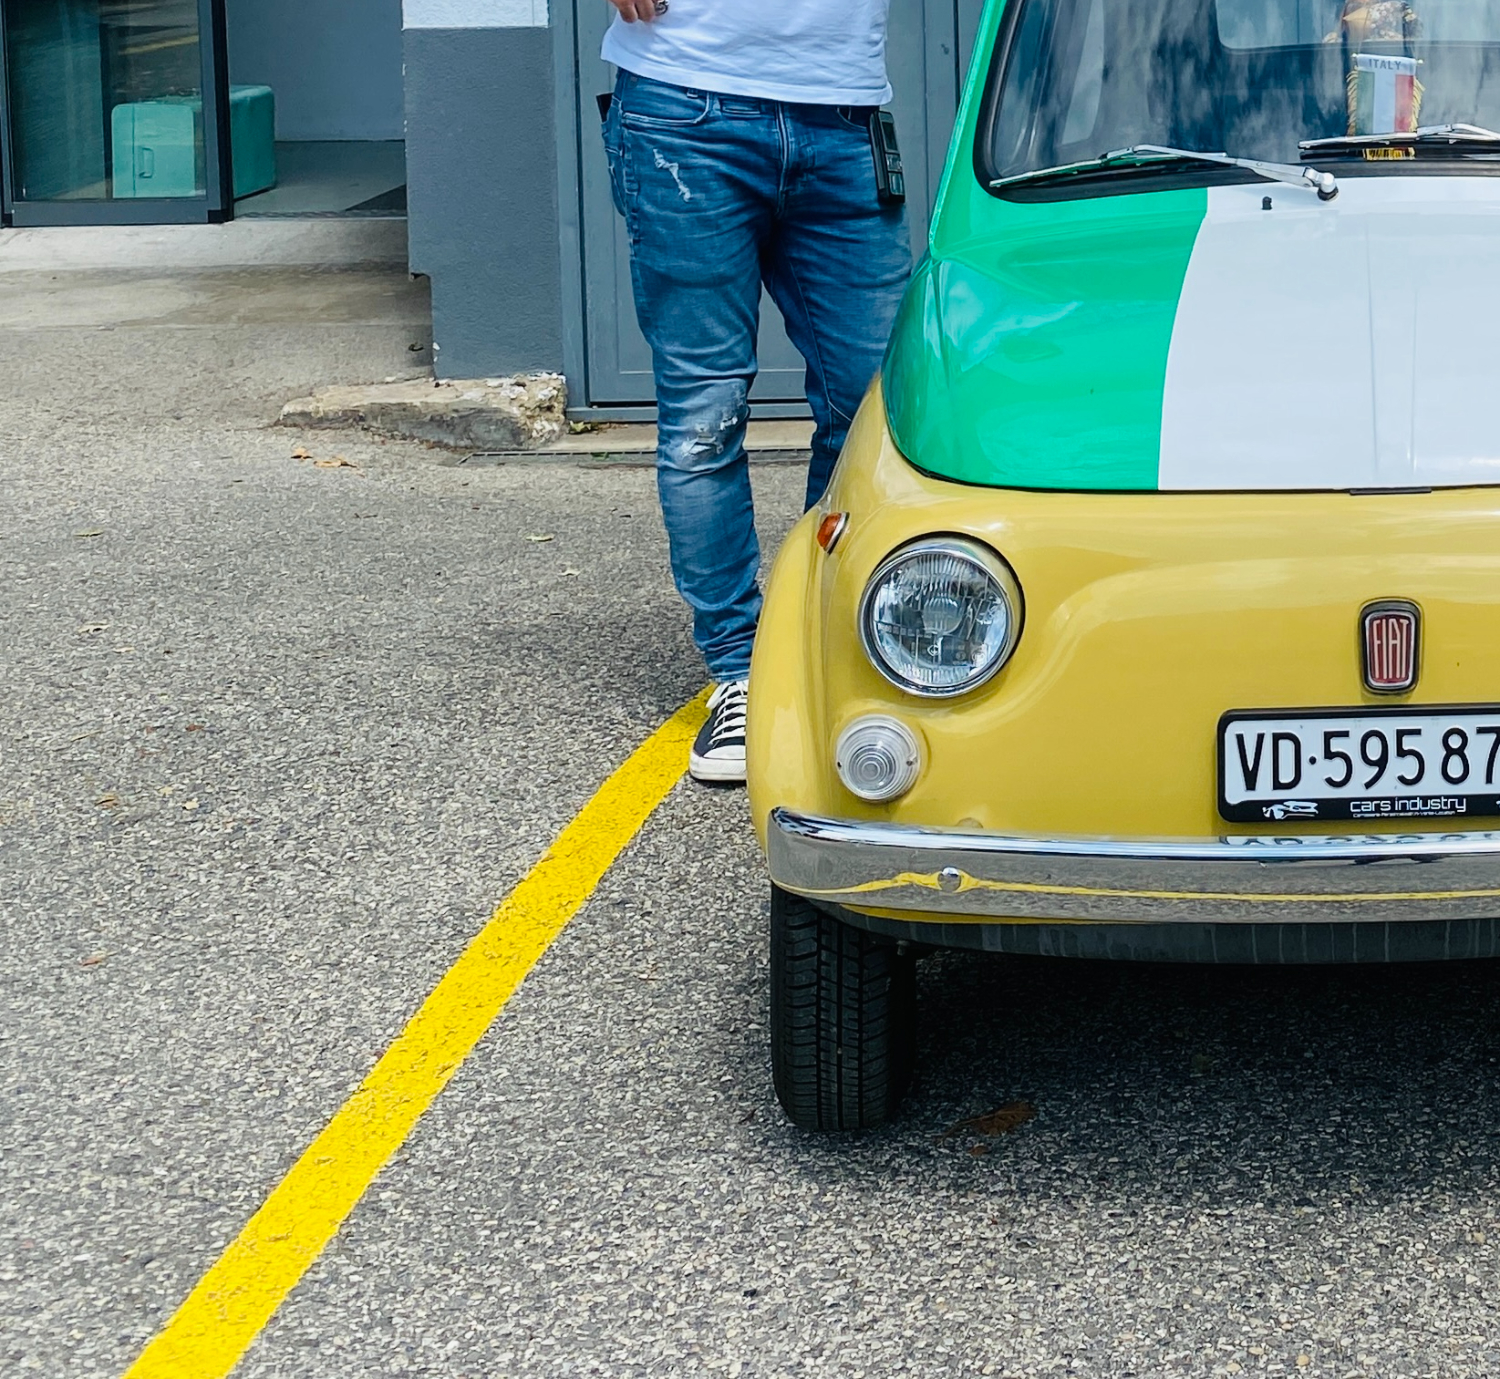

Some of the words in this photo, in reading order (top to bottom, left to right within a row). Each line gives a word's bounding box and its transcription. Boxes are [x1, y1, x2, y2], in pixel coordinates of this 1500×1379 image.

[1368, 58, 1402, 71] ITALY
[1371, 617, 1410, 681] FIAT
[1350, 800, 1392, 813] cars
[1394, 796, 1467, 813] industry
